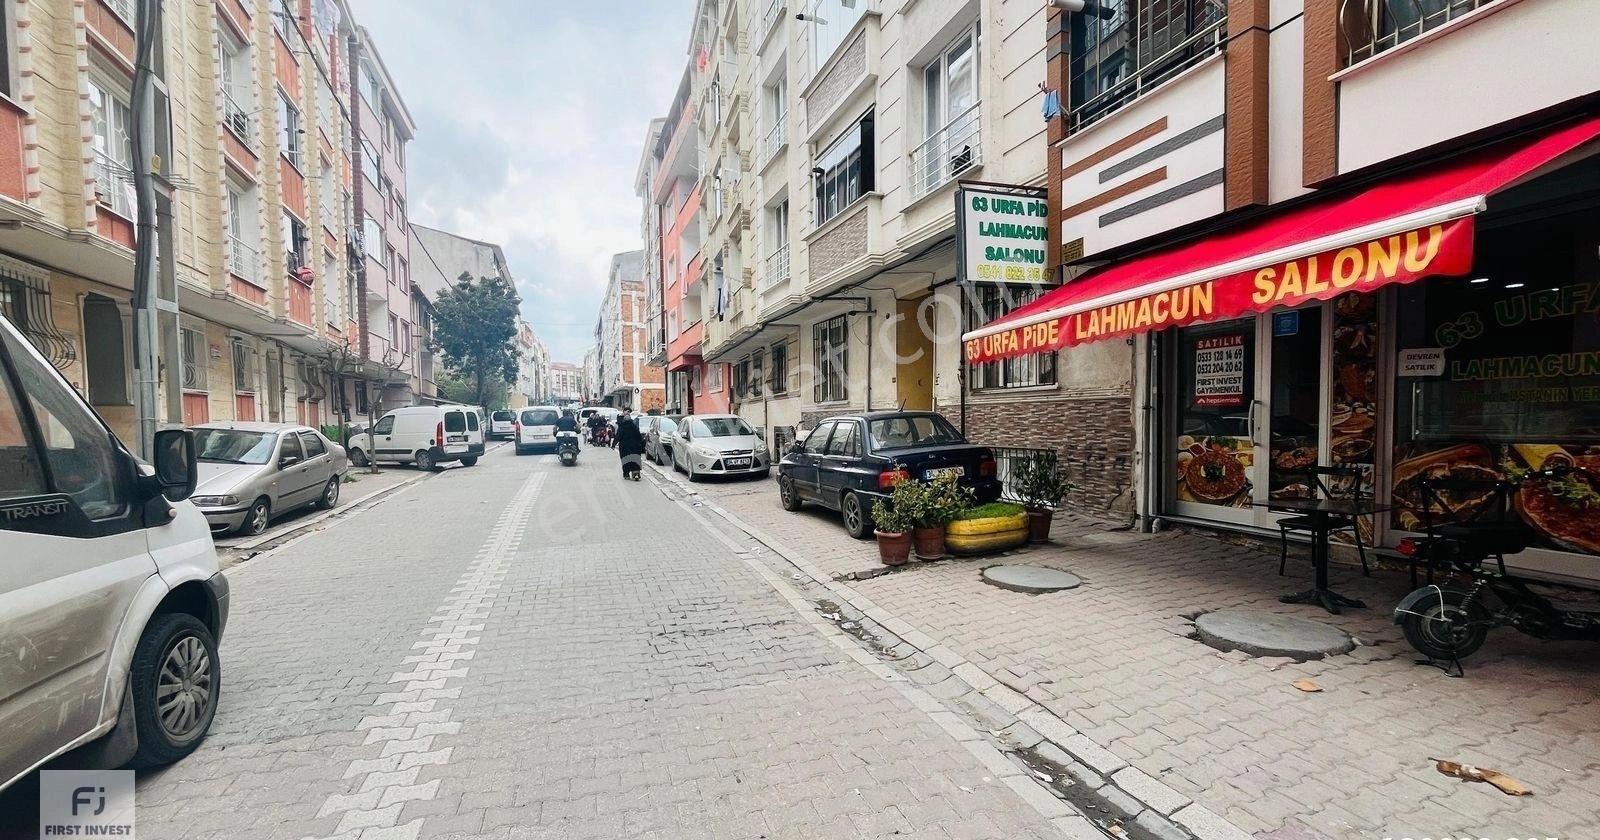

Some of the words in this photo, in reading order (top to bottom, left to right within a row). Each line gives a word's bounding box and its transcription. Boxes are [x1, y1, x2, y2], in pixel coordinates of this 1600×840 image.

[972, 196, 988, 213] 63
[991, 198, 1025, 216] URFA
[1027, 199, 1048, 218] PİD
[979, 221, 1049, 241] LAHMACUN
[985, 245, 1045, 264] SALONU
[977, 264, 1002, 280] 0541
[1005, 265, 1025, 281] 822
[1027, 267, 1041, 281] 35
[1042, 267, 1056, 281] 47
[966, 339, 980, 361] 63
[983, 329, 1019, 357] URFA
[1076, 281, 1214, 340] LAHMACUN
[1252, 225, 1443, 305] SALONU
[1435, 311, 1485, 349] 63
[1198, 335, 1242, 349] SATILIK
[1197, 352, 1212, 363] 0533
[1234, 348, 1243, 359] 69
[1406, 353, 1440, 361] DEVREN
[1197, 363, 1212, 374] 0532
[1213, 362, 1224, 373] 204
[1225, 361, 1234, 372] 20
[1234, 361, 1243, 371] 62
[1450, 351, 1600, 382] LAHMACUN
[1197, 378, 1215, 386] FIRST
[1216, 376, 1242, 385] INVEST
[5, 502, 68, 520] TRANSIT
